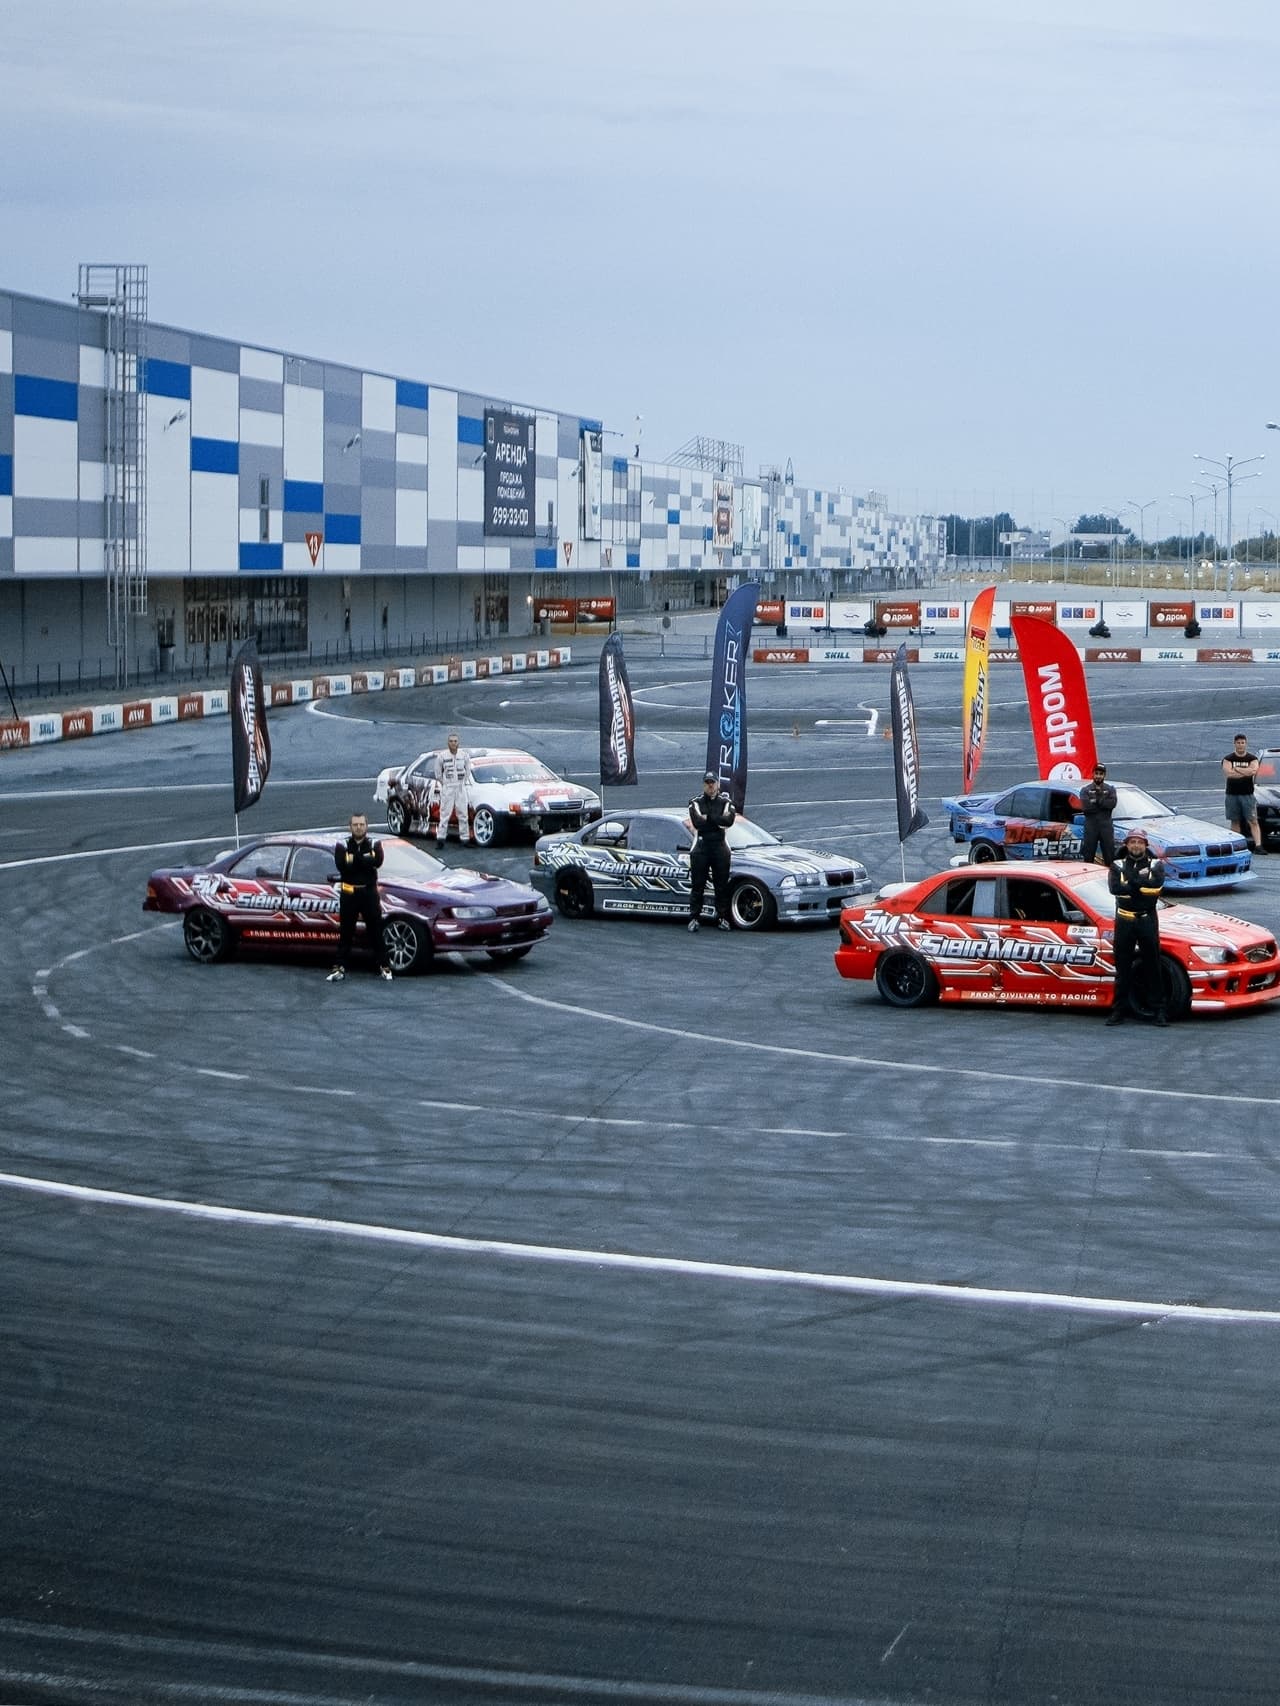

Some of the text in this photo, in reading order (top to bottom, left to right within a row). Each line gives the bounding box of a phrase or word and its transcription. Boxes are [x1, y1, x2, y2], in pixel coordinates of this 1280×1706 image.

[495, 442, 527, 467] АРЕНДА
[310, 535, 318, 555] 13
[791, 607, 823, 617] SKR
[927, 608, 959, 618] SKR
[1062, 608, 1095, 618] SKR
[1201, 608, 1234, 618] SKR
[933, 652, 960, 660] SKILL
[1038, 663, 1078, 754] дром
[237, 893, 341, 912] SIBIRMOTOR
[863, 910, 899, 934] SM
